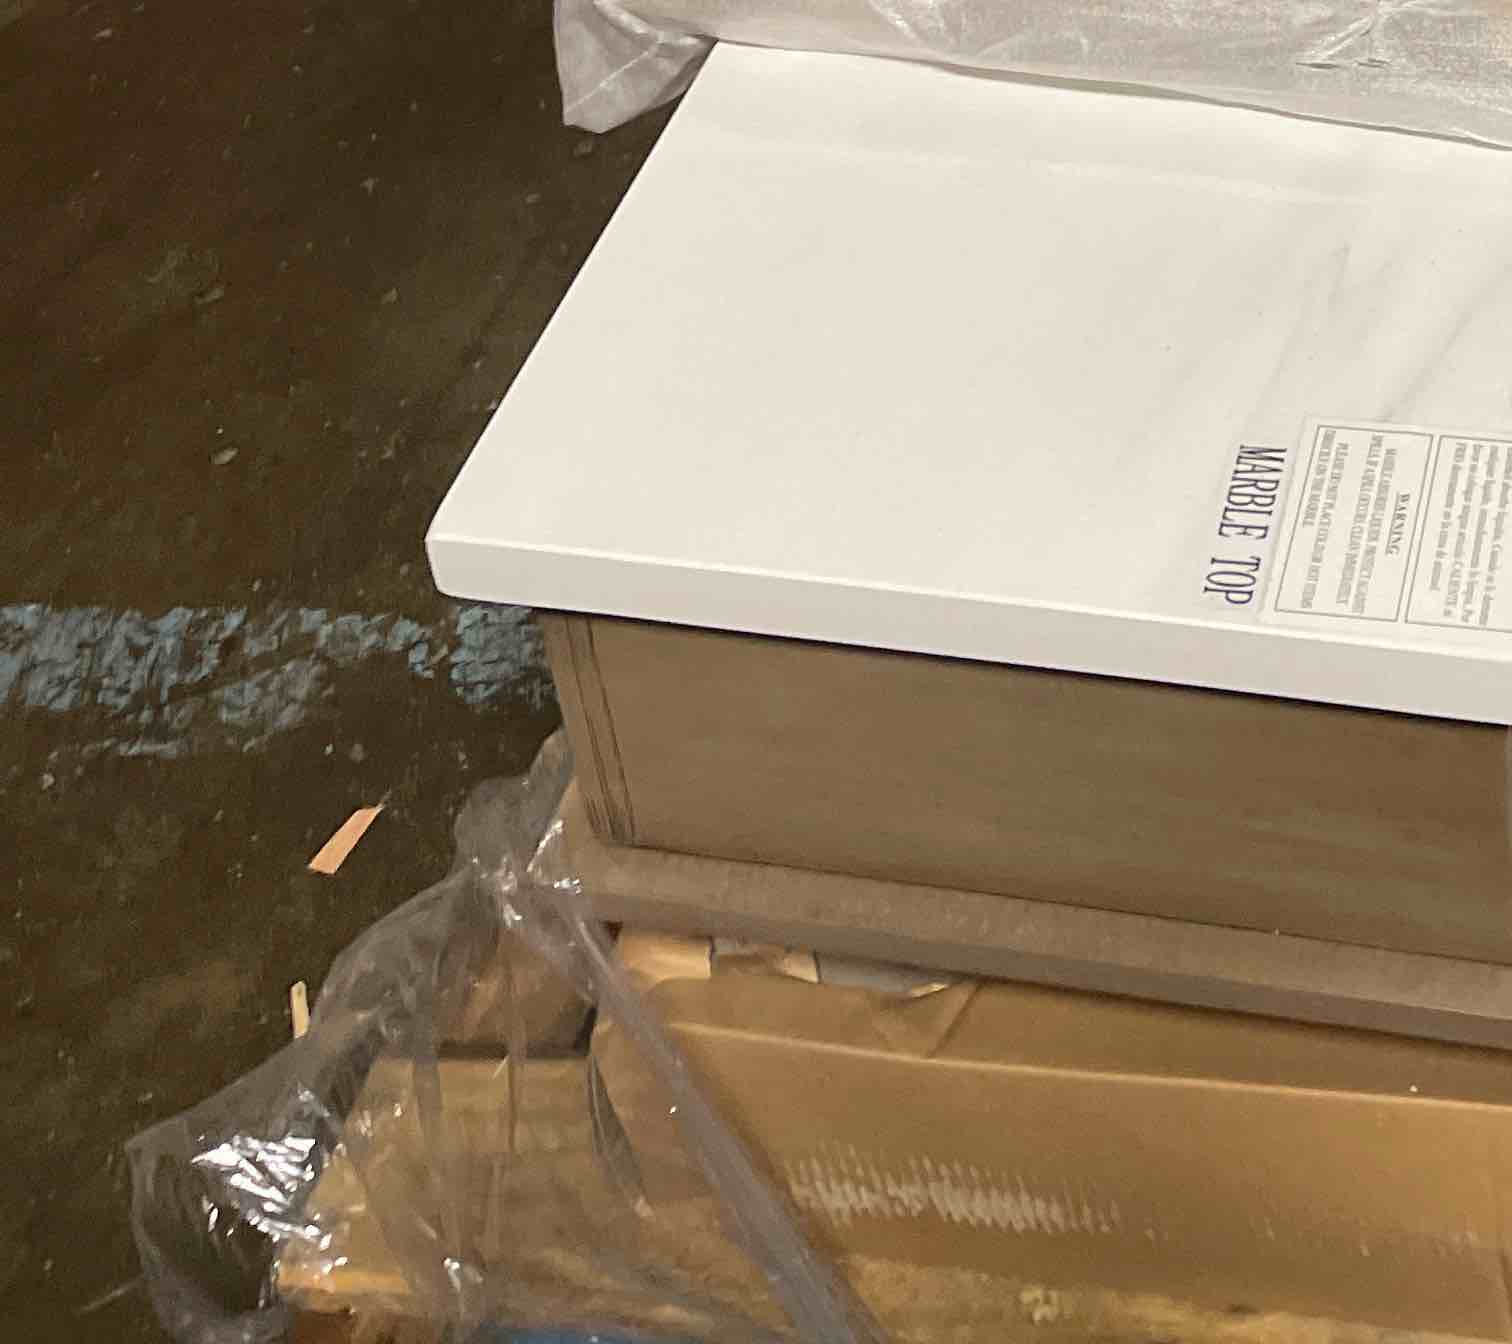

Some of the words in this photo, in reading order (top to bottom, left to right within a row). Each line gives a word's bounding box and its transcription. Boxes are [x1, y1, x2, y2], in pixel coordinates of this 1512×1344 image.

[1219, 444, 1287, 539] MARBLE
[1387, 493, 1411, 556] WARNING
[1204, 556, 1261, 604] TOP
